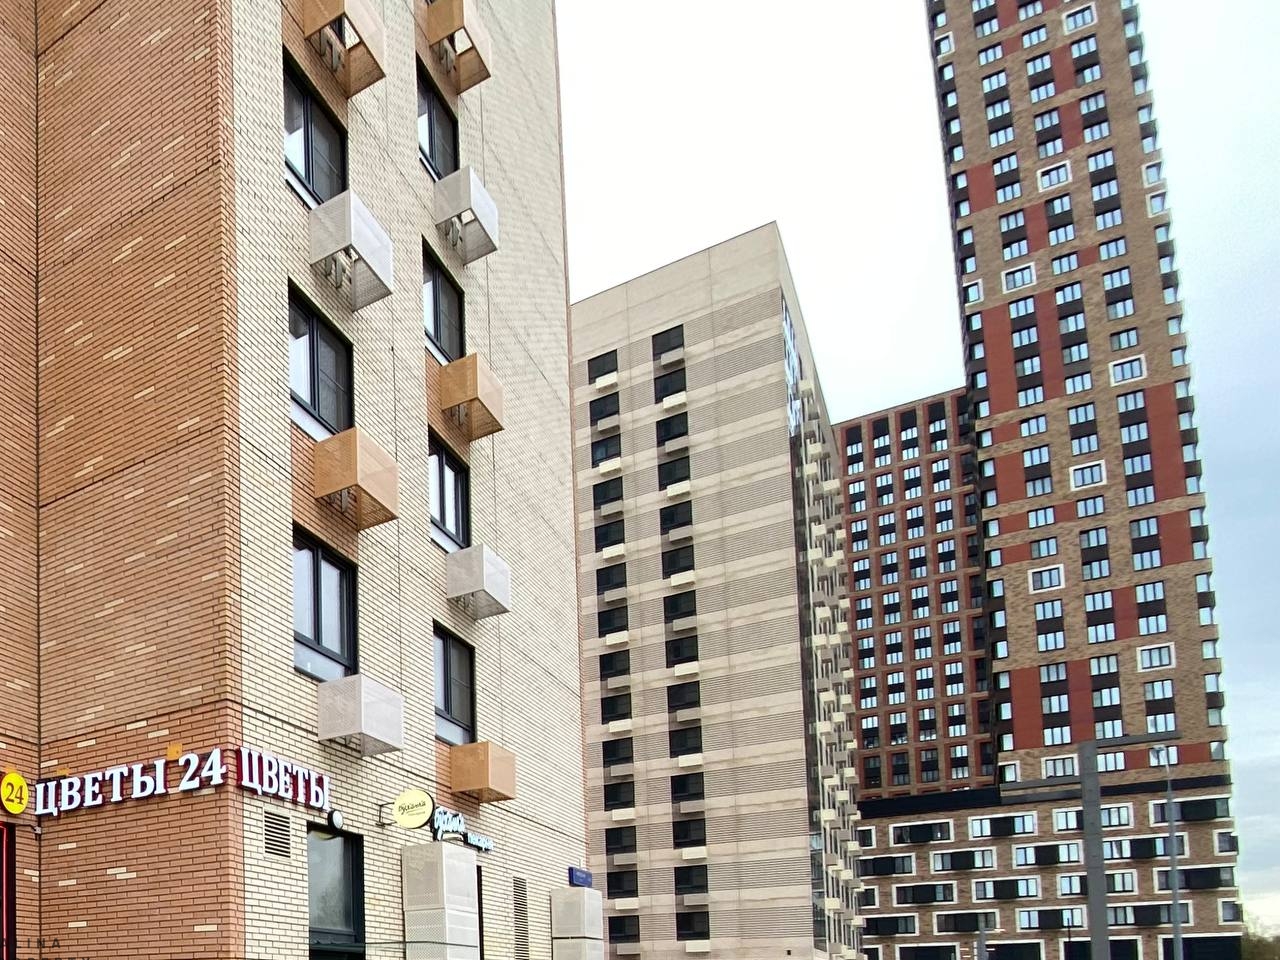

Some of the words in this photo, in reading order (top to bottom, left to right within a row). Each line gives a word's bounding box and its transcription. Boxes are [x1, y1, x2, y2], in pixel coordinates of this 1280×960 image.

[4, 781, 25, 805] 24
[34, 758, 168, 817] ЦВЕТЫ
[178, 747, 227, 791] 24
[240, 746, 332, 812] ЦВЕТЫ
